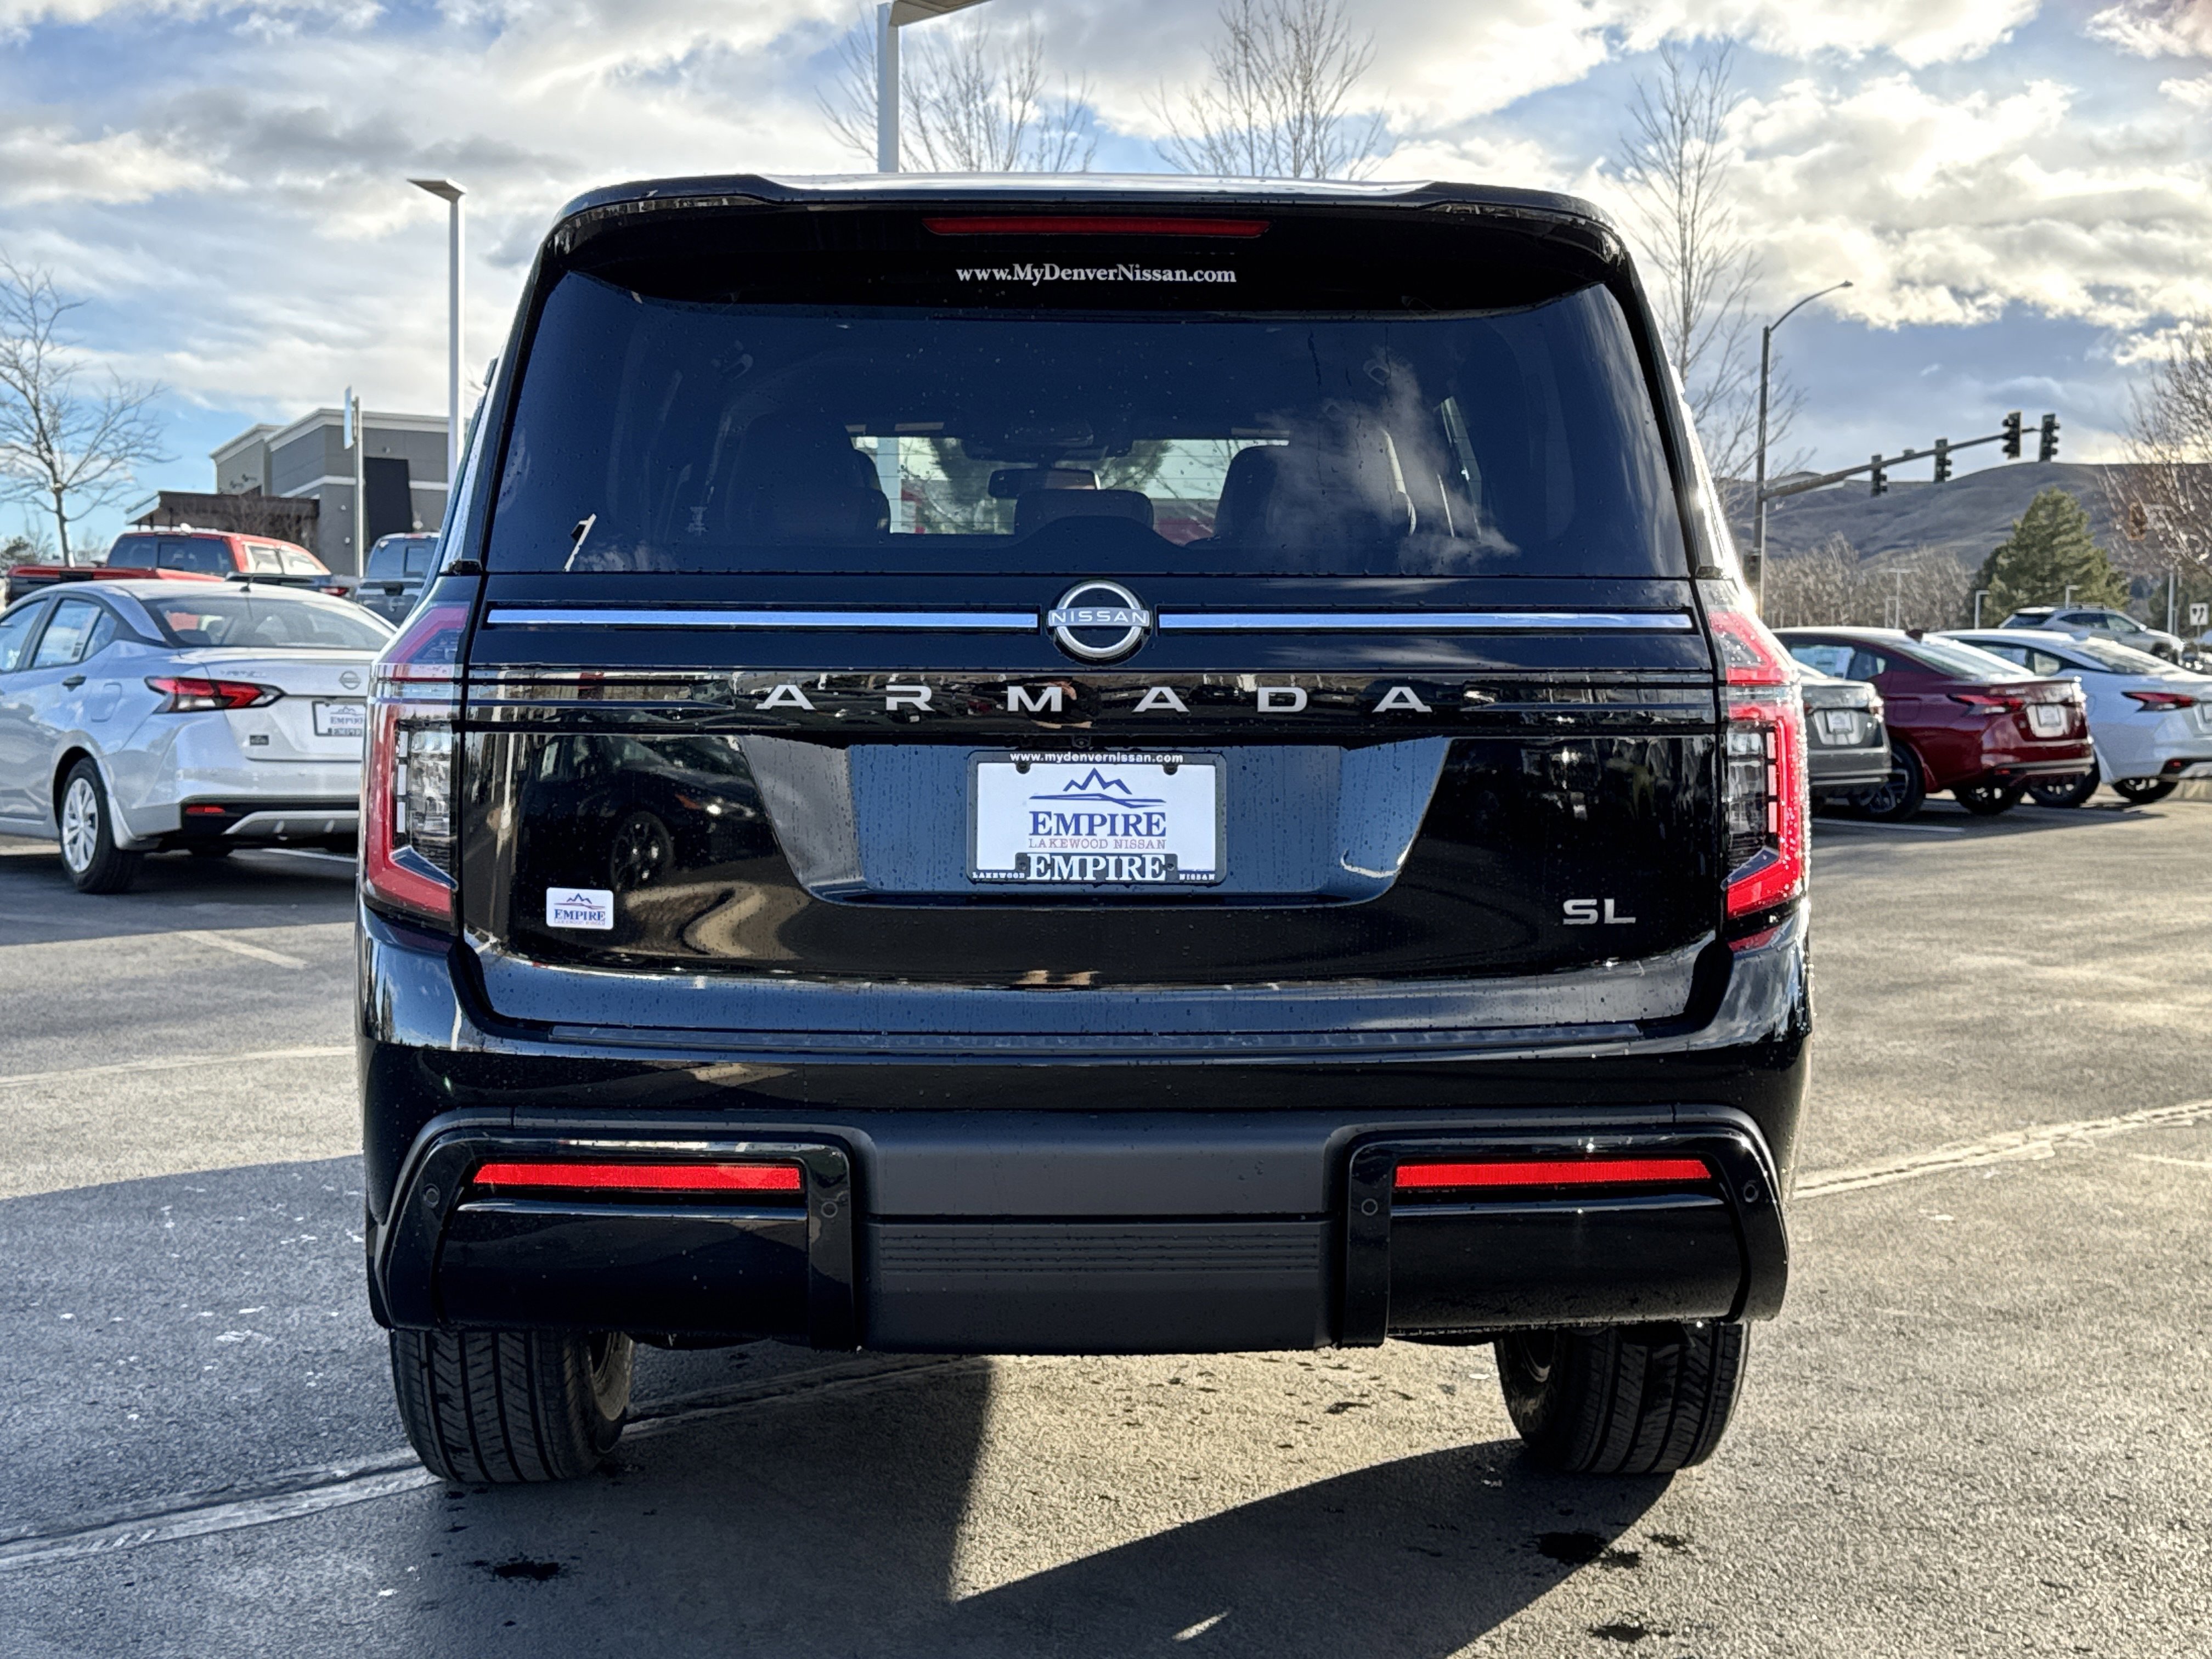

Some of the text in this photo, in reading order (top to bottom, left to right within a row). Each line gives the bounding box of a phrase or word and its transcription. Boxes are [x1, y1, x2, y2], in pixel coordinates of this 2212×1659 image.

[956, 263, 1237, 286] www.MyDenverNissan.com
[1051, 610, 1147, 624] NISSAN
[754, 684, 1432, 714] ARMADA
[1010, 752, 1183, 763] www.mydenvernissan.com
[1029, 811, 1166, 837] EMPIRE
[1028, 838, 1167, 850] LAKEWOOD NISSAN
[1026, 853, 1166, 881] EMPIRE
[555, 909, 606, 921] EMPIRE
[1562, 898, 1637, 925] SL
